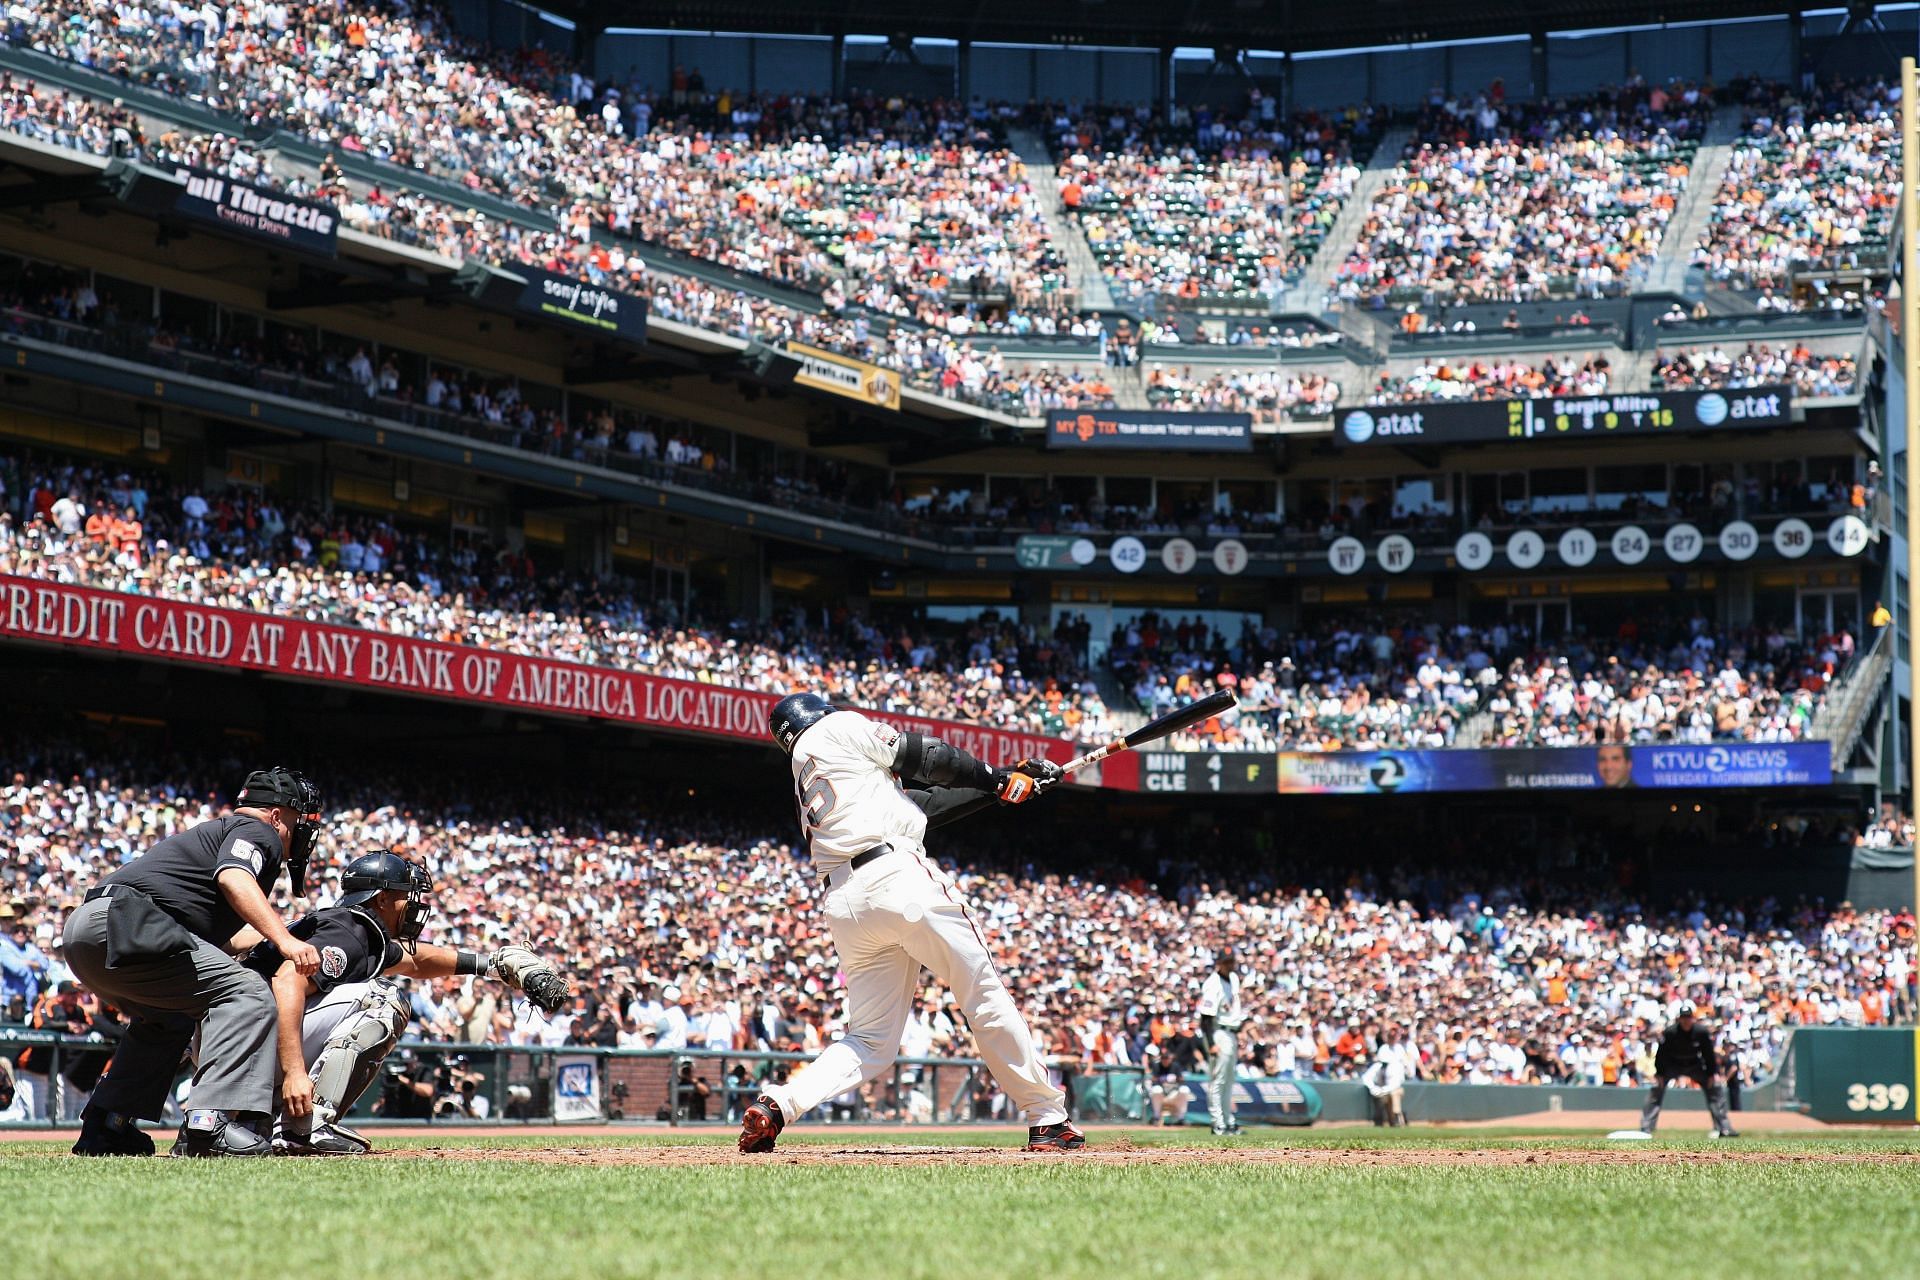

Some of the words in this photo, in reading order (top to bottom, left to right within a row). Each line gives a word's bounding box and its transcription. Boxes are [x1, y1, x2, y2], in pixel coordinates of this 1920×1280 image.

[230, 184, 333, 235] Throttle
[544, 280, 582, 311] sony
[581, 291, 618, 318] style
[1553, 399, 1610, 416] Sergio
[1613, 397, 1660, 413] Mitre
[1730, 395, 1781, 418] at&t
[1056, 420, 1076, 434] MY
[1097, 421, 1118, 434] TIX
[1376, 411, 1424, 435] at&t
[1556, 414, 1569, 431] 6
[1604, 412, 1618, 429] 9
[1632, 412, 1643, 427] T
[1651, 410, 1674, 427] 15
[1672, 535, 1696, 550] 27
[1728, 532, 1752, 548] 30
[1834, 528, 1860, 543] 44
[1468, 543, 1480, 559] 3
[1518, 542, 1530, 557] 4
[1571, 540, 1584, 555] 11
[1619, 538, 1643, 553] 24
[1117, 548, 1140, 563] 42
[0, 584, 124, 644] REDIT
[135, 604, 232, 659] CARD
[240, 622, 285, 667] AT
[292, 630, 361, 677] ANY
[369, 639, 455, 692] BANK
[462, 654, 502, 697] OF
[508, 663, 636, 717] AMERICA
[1000, 738, 1052, 769] PARK
[1146, 755, 1186, 770] MIN
[1207, 755, 1222, 771] 4
[1652, 751, 1704, 769] KTVU
[1732, 749, 1788, 768] NEWS
[1247, 764, 1260, 782] F
[1310, 774, 1367, 786] TRAFFIC
[1146, 774, 1186, 791] CLE
[1208, 774, 1220, 791] 1
[796, 755, 837, 840] 5
[1846, 1083, 1910, 1112] 339
